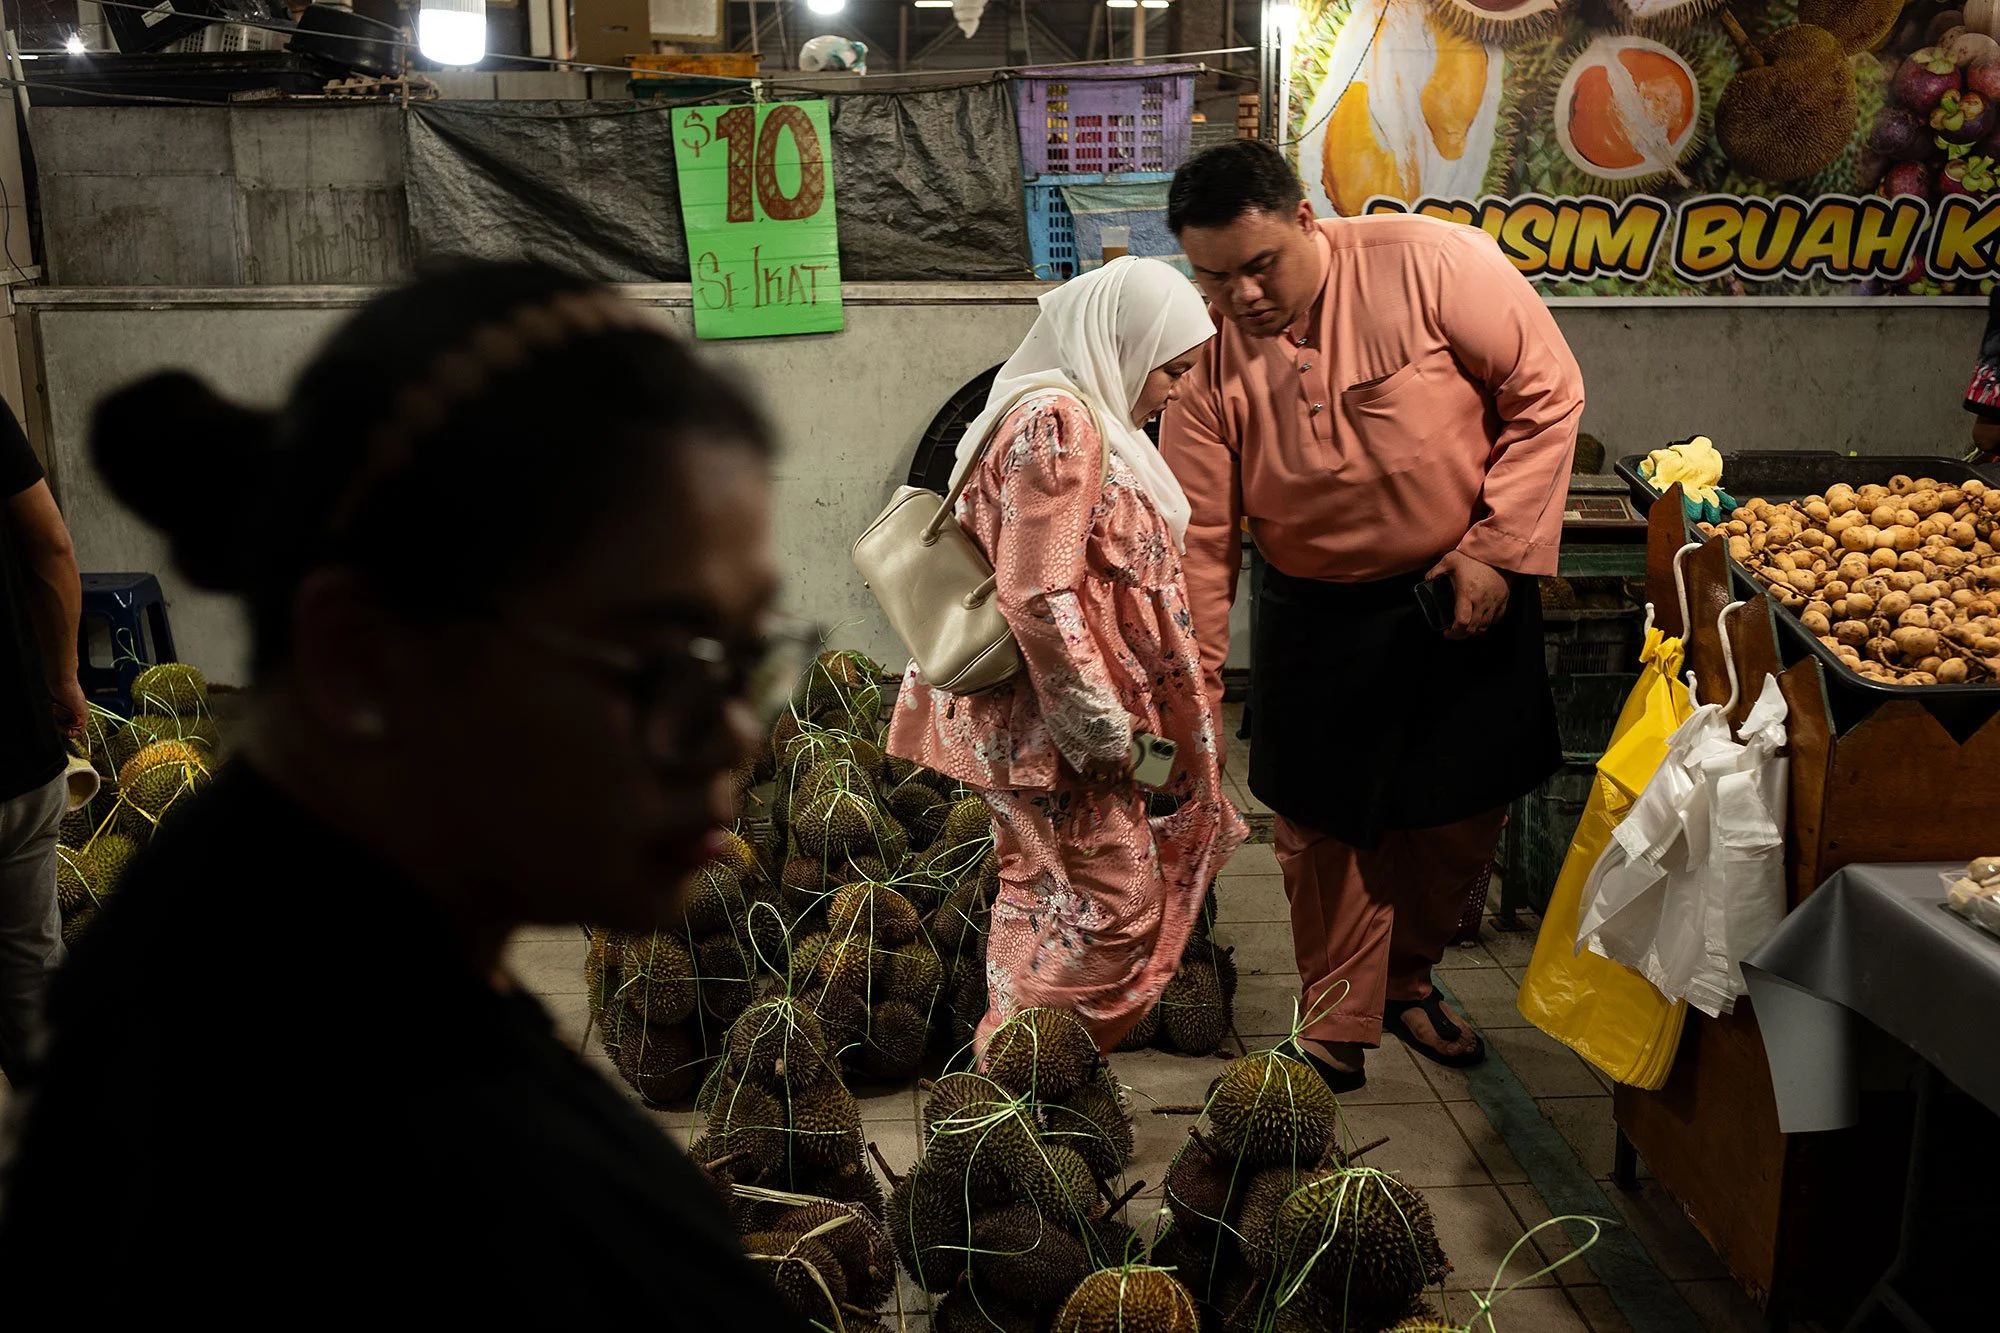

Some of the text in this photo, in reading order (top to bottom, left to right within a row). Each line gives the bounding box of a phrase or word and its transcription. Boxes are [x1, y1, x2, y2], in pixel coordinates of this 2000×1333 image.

[682, 105, 825, 223] $10
[1367, 200, 2000, 275] SIM BUAH K
